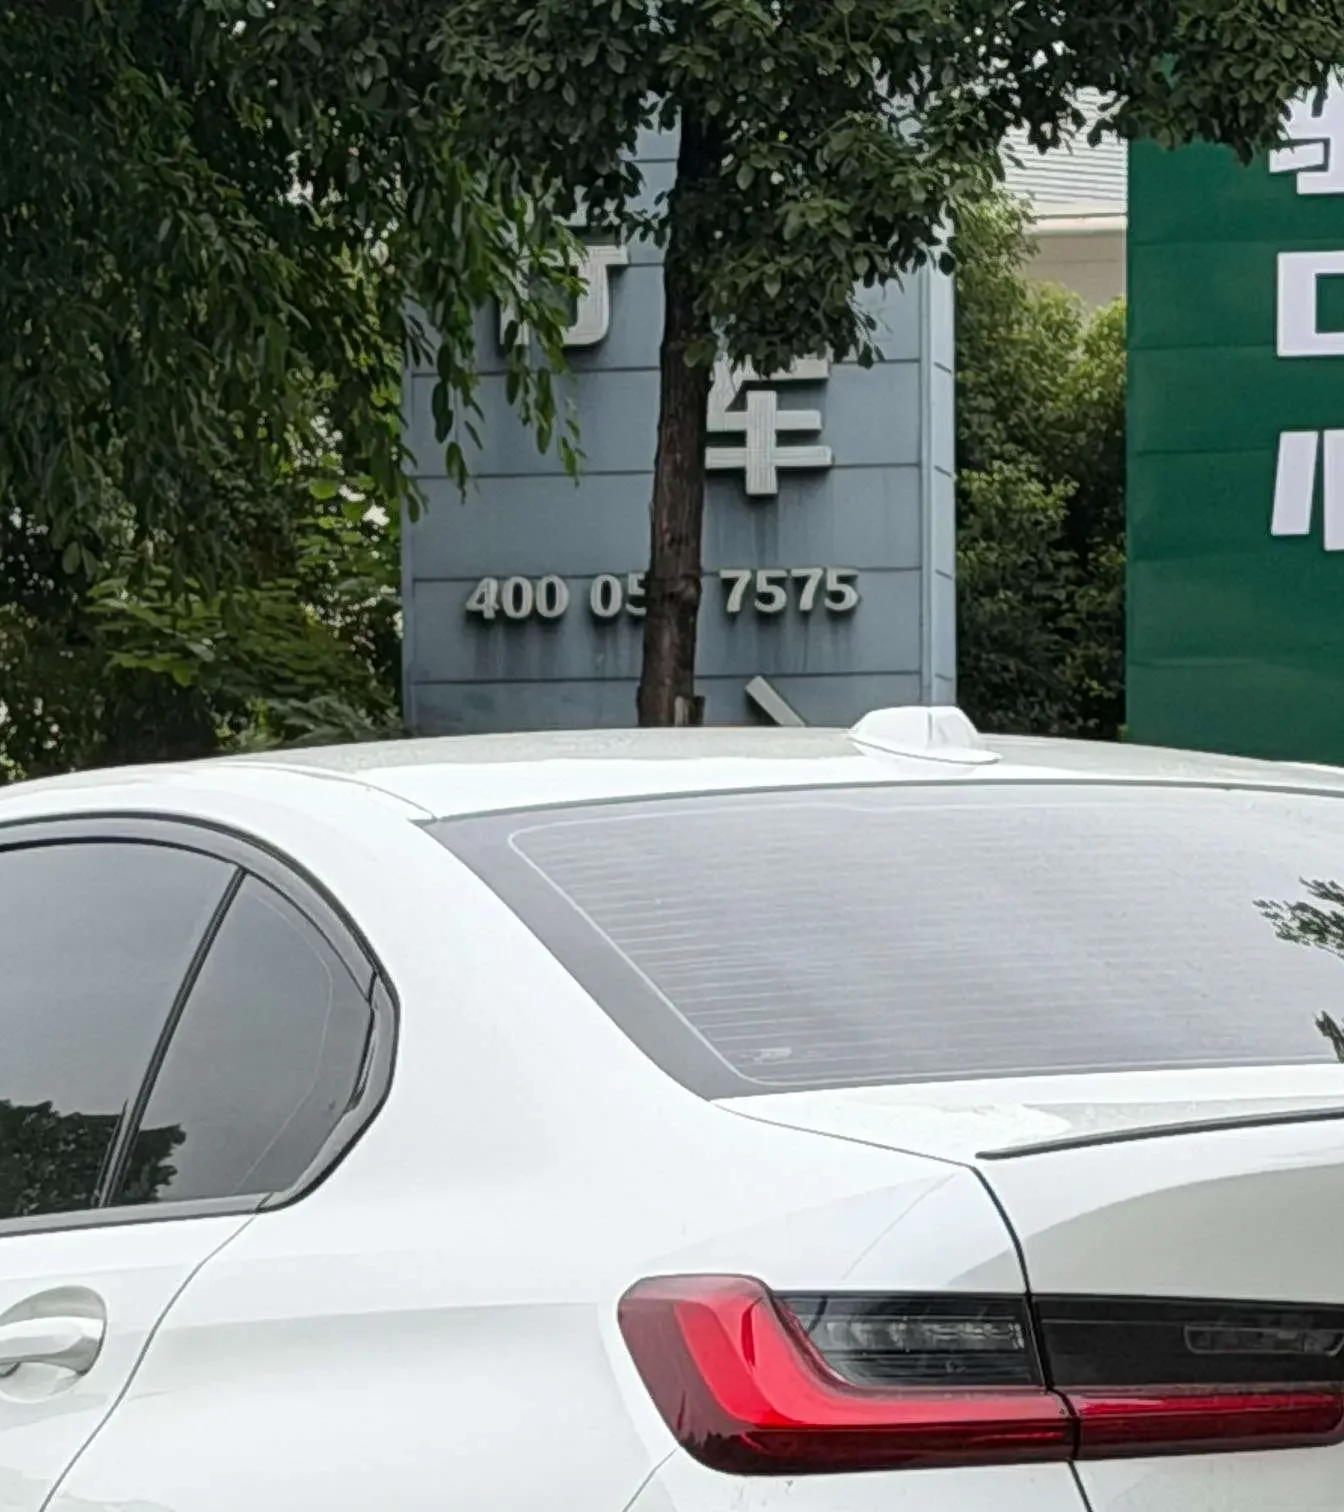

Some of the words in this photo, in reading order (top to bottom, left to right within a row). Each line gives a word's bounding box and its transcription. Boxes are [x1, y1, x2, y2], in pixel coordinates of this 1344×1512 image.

[466, 573, 570, 619] 400
[589, 573, 648, 619] 05
[719, 567, 859, 613] 7575
